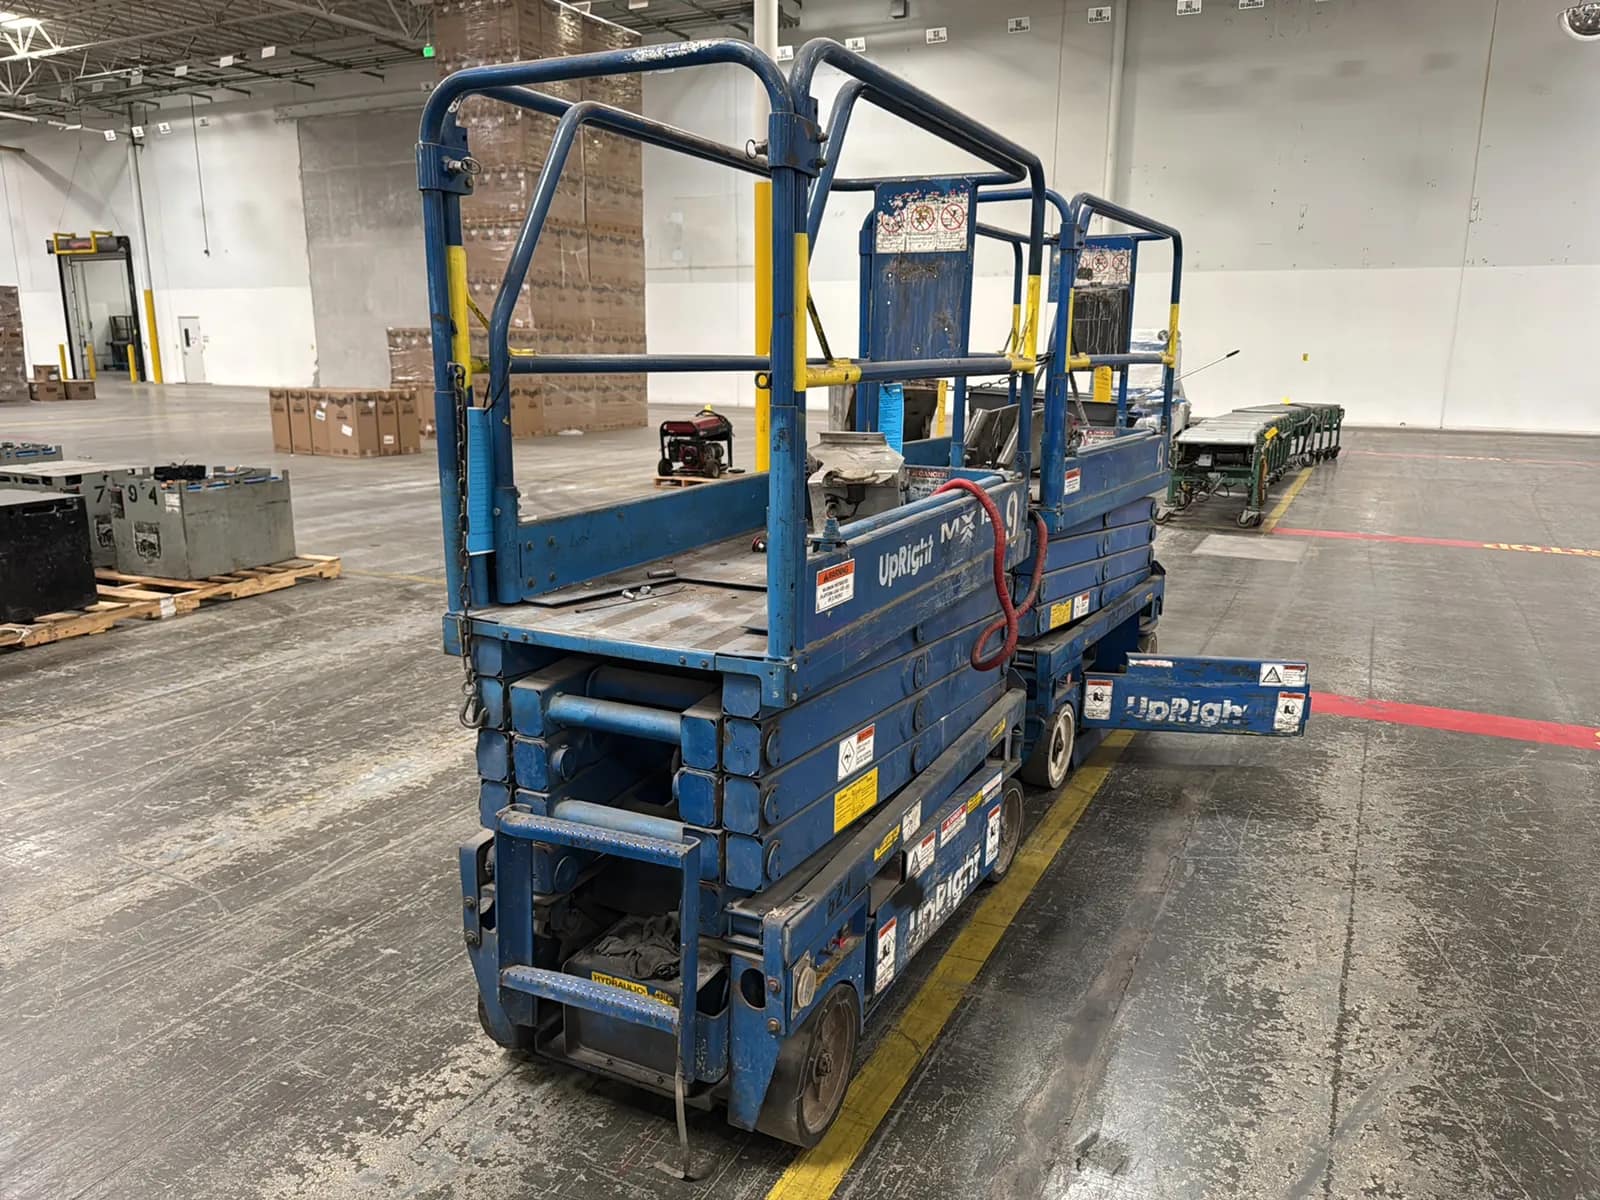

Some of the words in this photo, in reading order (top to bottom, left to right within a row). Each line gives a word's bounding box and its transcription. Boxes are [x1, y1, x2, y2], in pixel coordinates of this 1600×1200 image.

[1005, 490, 1019, 548] 9
[878, 534, 934, 587] UpRight
[940, 510, 977, 545] MX
[593, 974, 647, 996] HYDRAULIC
